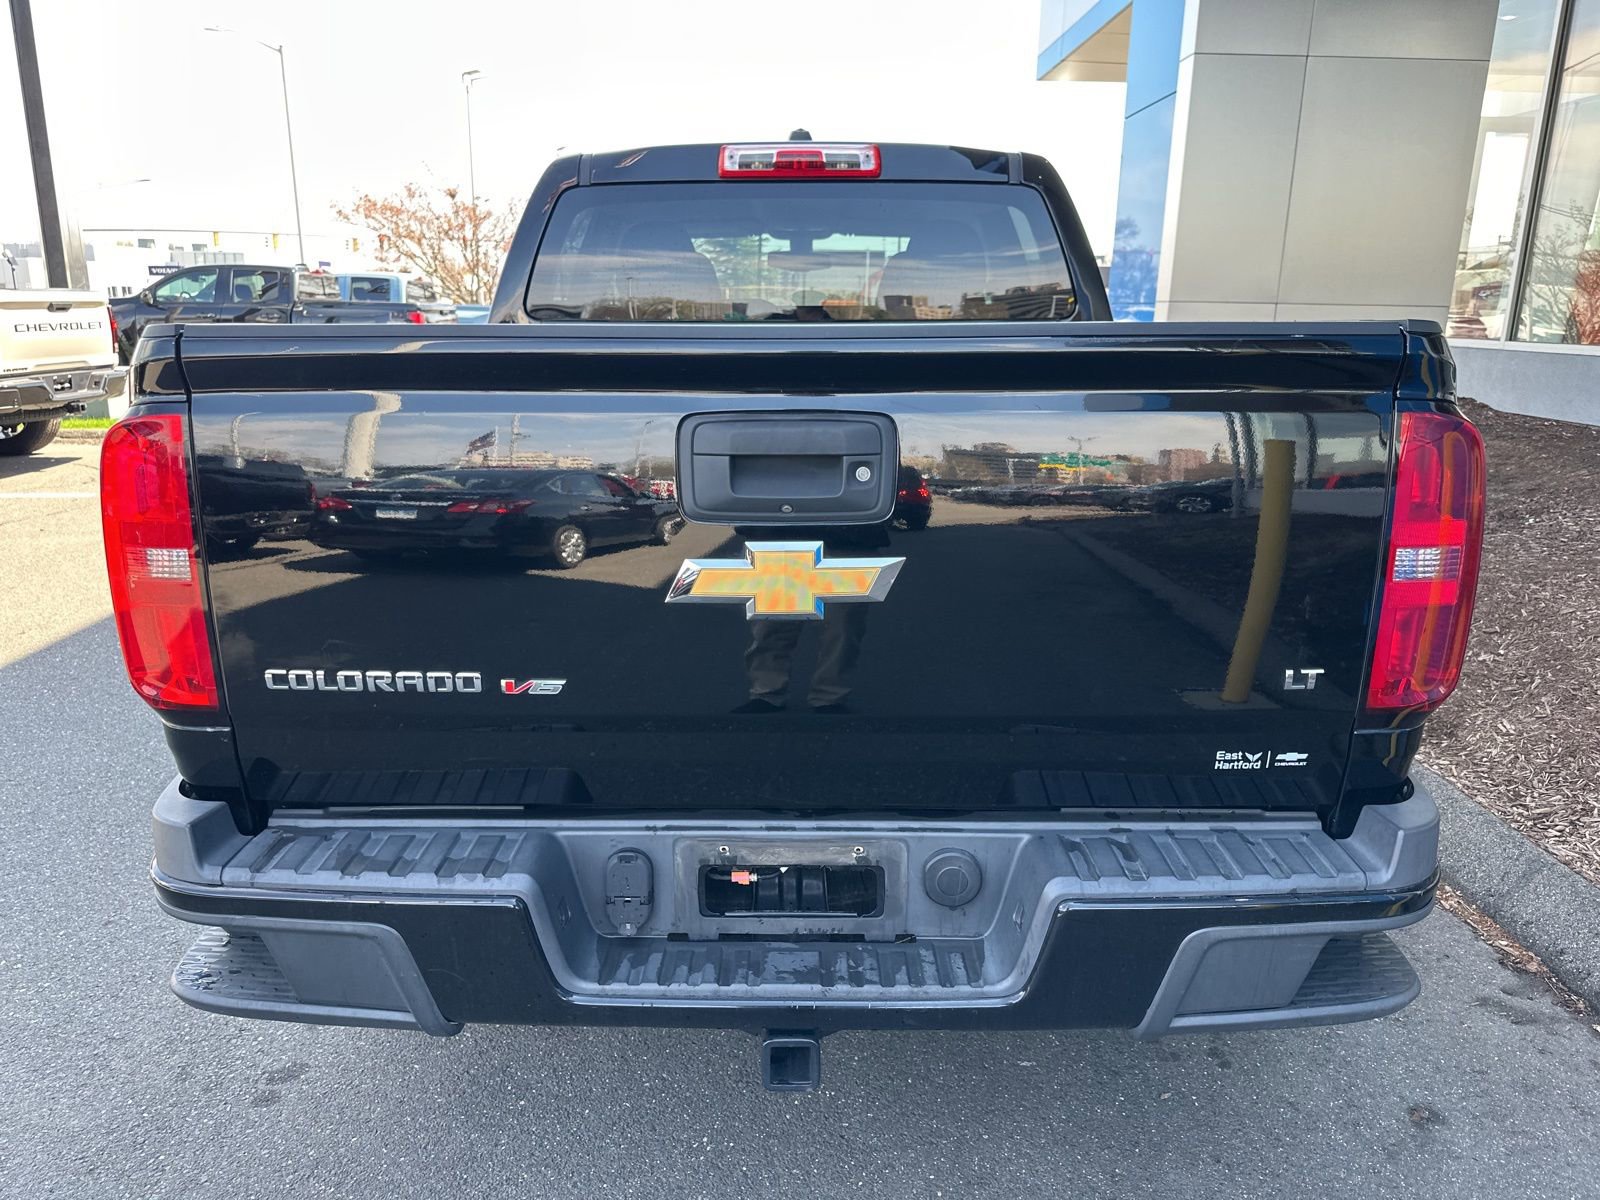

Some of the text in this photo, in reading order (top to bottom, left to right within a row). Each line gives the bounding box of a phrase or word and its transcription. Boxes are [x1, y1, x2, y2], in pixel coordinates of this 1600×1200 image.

[14, 321, 102, 332] CHEVROLET
[264, 669, 567, 695] COLORADO V6
[1283, 668, 1325, 690] LT
[1215, 750, 1243, 760] East
[1214, 760, 1262, 770] Hartford
